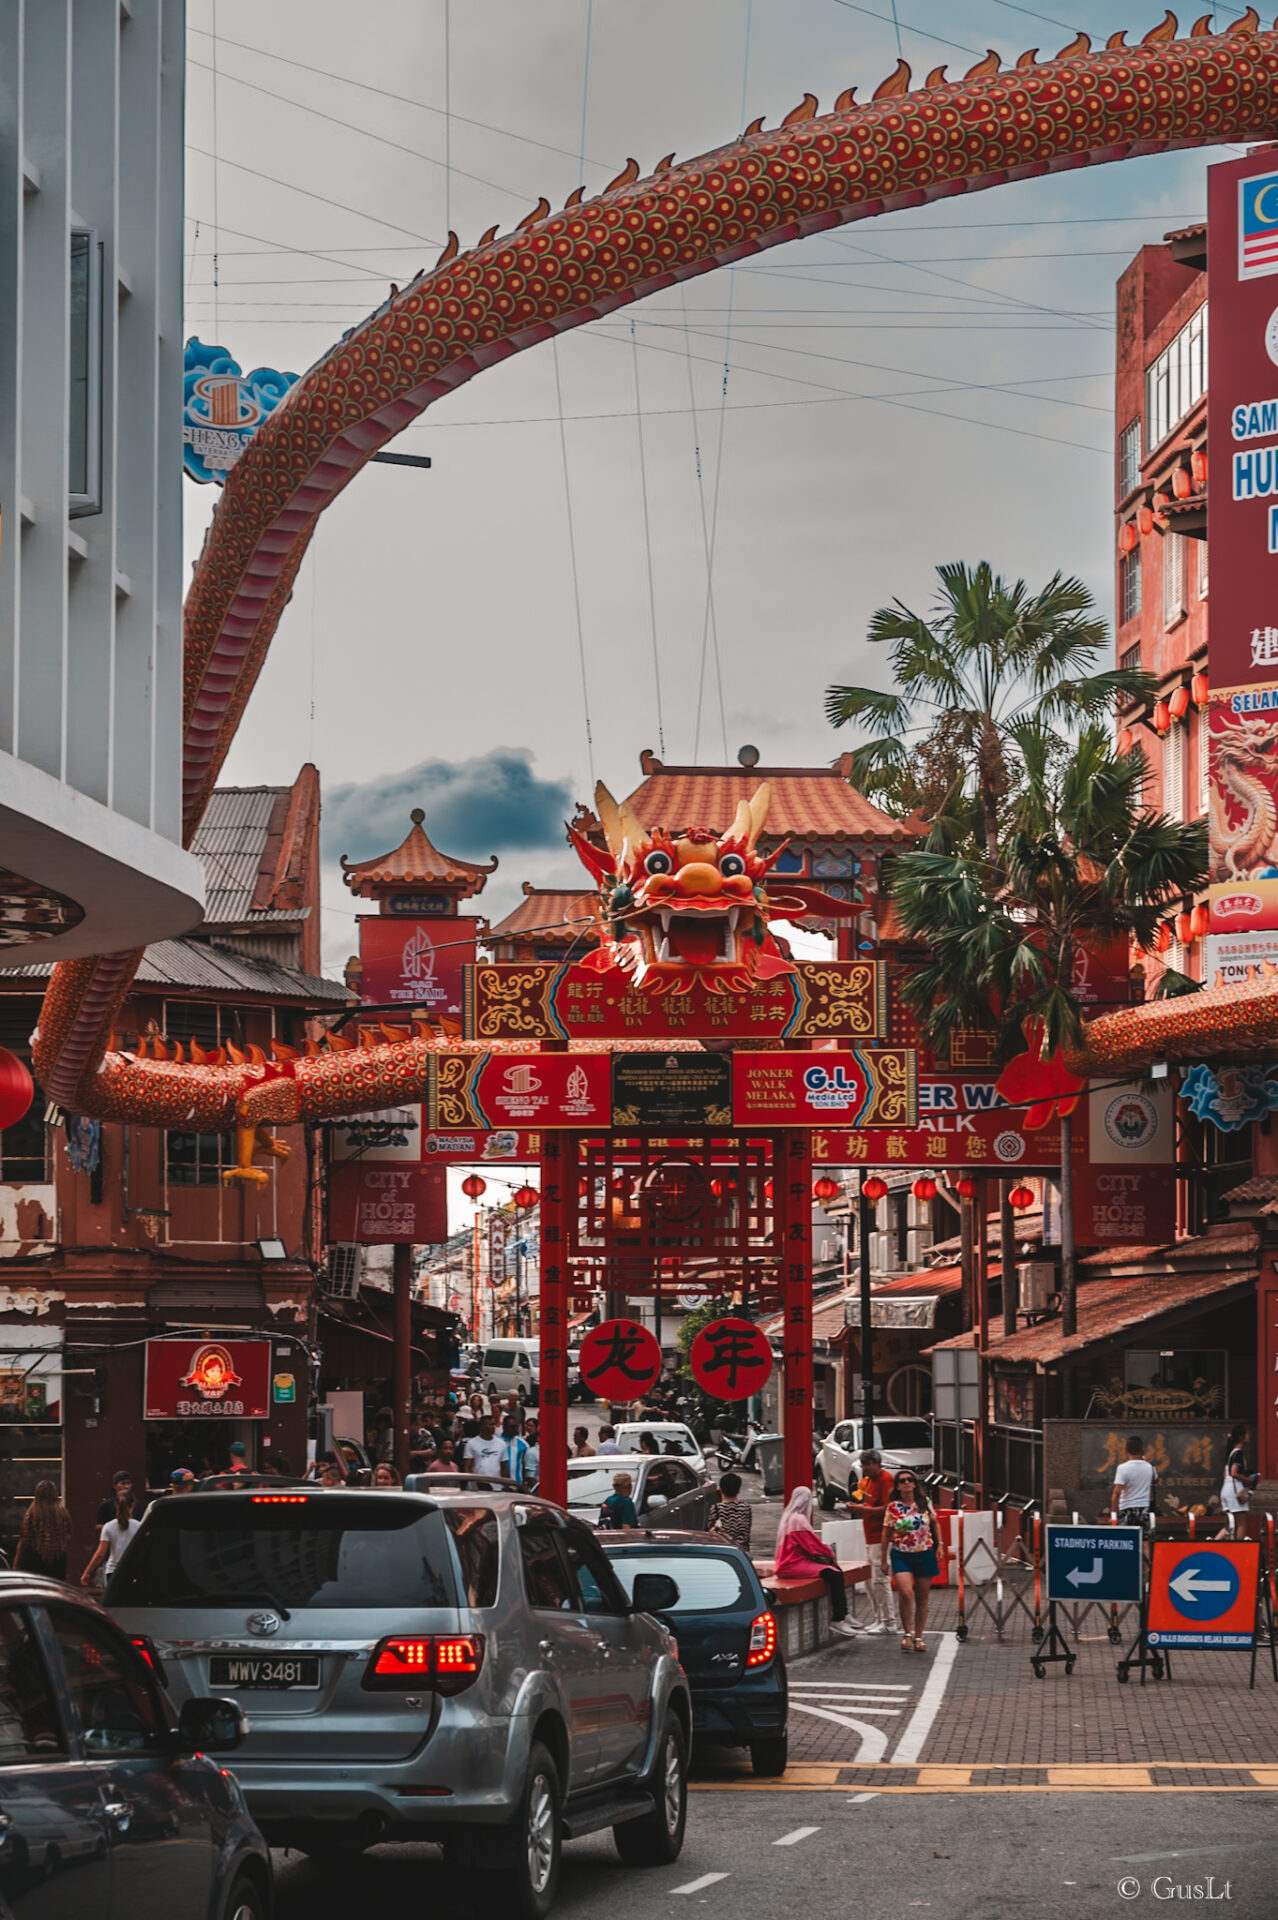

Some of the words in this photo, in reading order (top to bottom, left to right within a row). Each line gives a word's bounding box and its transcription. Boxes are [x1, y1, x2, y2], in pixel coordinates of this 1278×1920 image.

[415, 987, 447, 999] SAIL
[567, 982, 604, 998] 龍行
[625, 1017, 643, 1026] DA
[668, 1017, 686, 1026] DA
[711, 1017, 729, 1026] DA
[747, 1069, 793, 1079] JONKER
[804, 1067, 857, 1091] G.L.
[751, 1080, 786, 1089] WALK
[746, 1091, 795, 1101] MELAKA
[807, 1092, 836, 1101] Media
[838, 1092, 855, 1101] Led
[365, 1171, 412, 1188] CITY
[1096, 1175, 1142, 1191] CITY
[381, 1189, 398, 1202] of
[1112, 1192, 1128, 1205] of
[361, 1203, 416, 1219] HOPE
[1092, 1205, 1146, 1221] HOPE
[587, 1325, 656, 1381] 龙
[702, 1324, 766, 1389] 年
[1166, 1477, 1217, 1486] STREET
[1054, 1537, 1097, 1549] STADHUYS
[1098, 1538, 1134, 1550] PARKING
[228, 1661, 260, 1682] WWV
[261, 1661, 302, 1682] 3481
